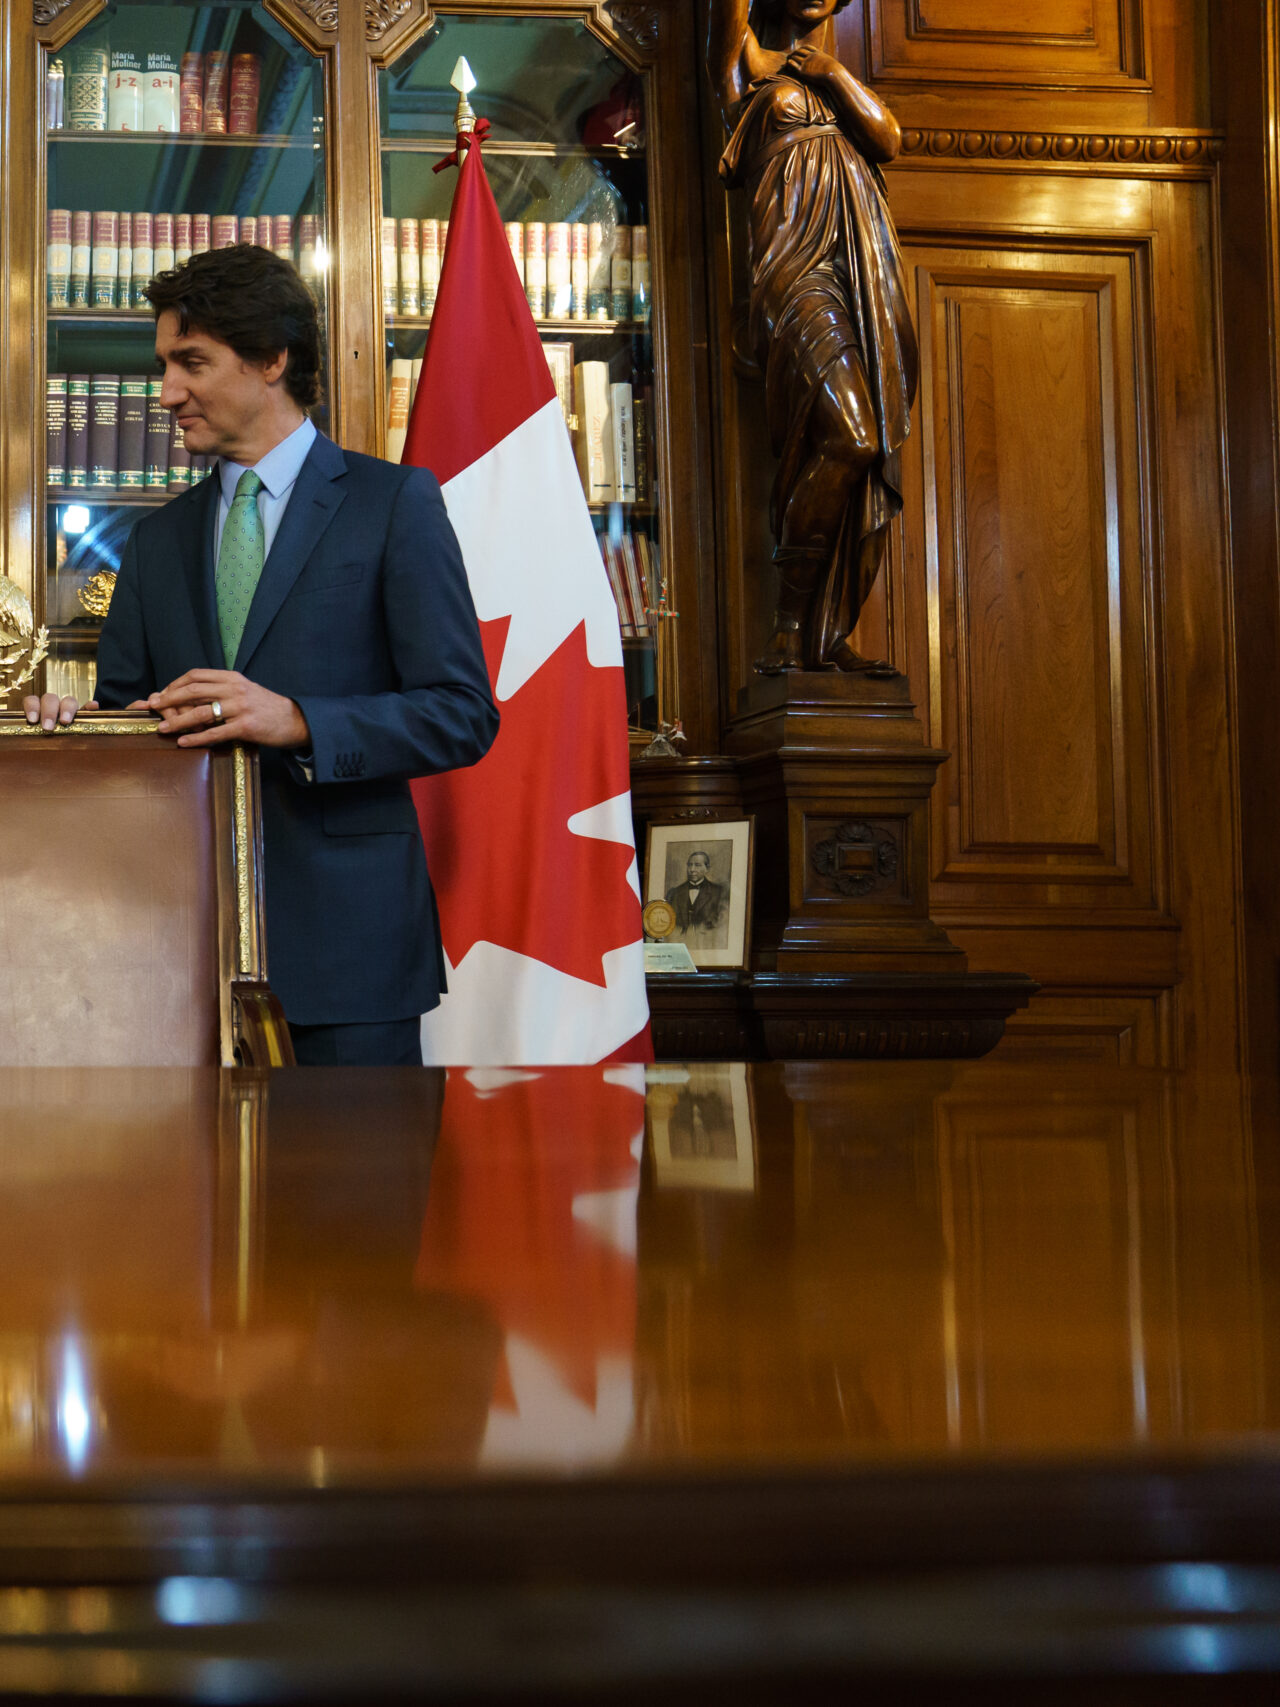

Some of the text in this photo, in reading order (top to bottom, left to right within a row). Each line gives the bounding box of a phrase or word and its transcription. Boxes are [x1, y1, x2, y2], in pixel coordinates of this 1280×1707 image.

[112, 60, 142, 69] Moliner
[148, 61, 178, 70] Moliner
[115, 74, 137, 88] j-z
[152, 76, 173, 88] a-i
